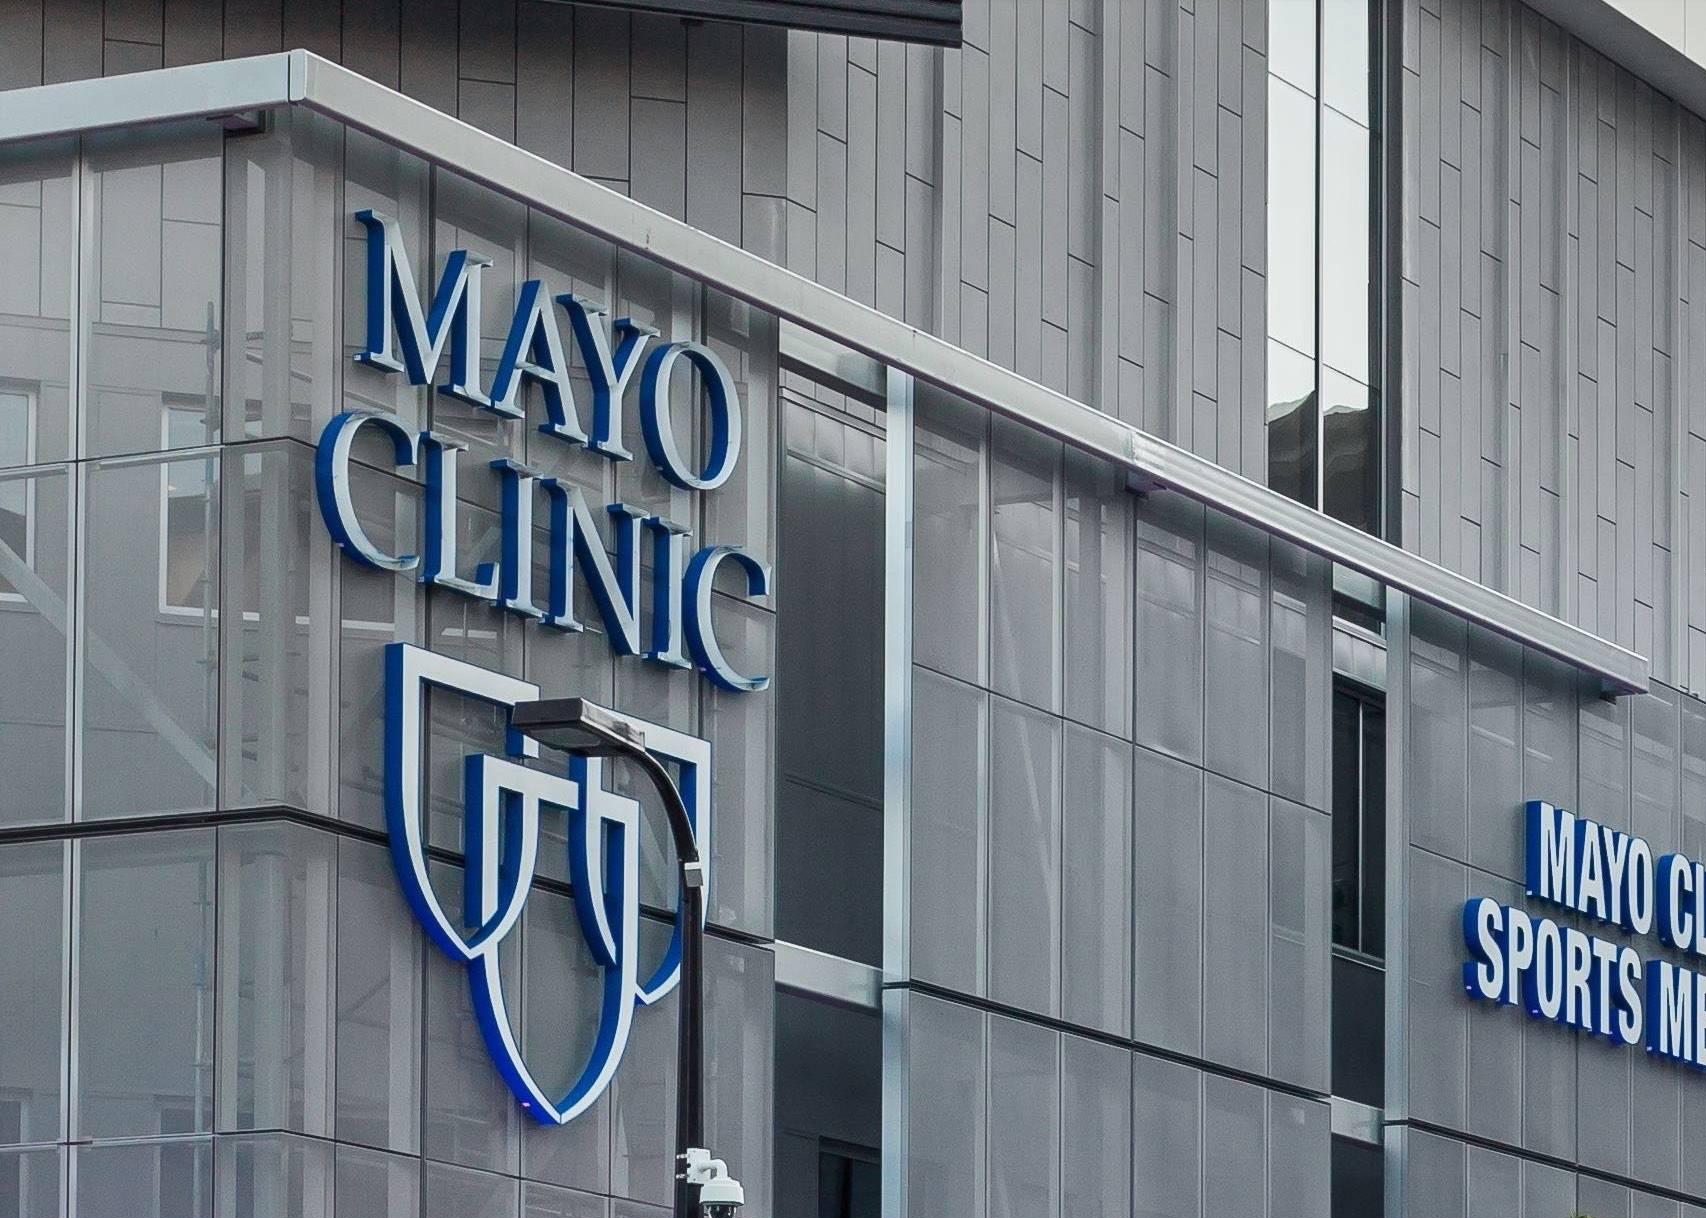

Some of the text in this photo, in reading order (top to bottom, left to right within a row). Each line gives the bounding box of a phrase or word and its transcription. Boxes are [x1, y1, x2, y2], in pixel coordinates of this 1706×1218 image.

[355, 209, 743, 491] MAYO
[315, 408, 772, 692] CLINIC
[1463, 897, 1642, 1045] SPORTS
[1526, 800, 1654, 935] MAYO
